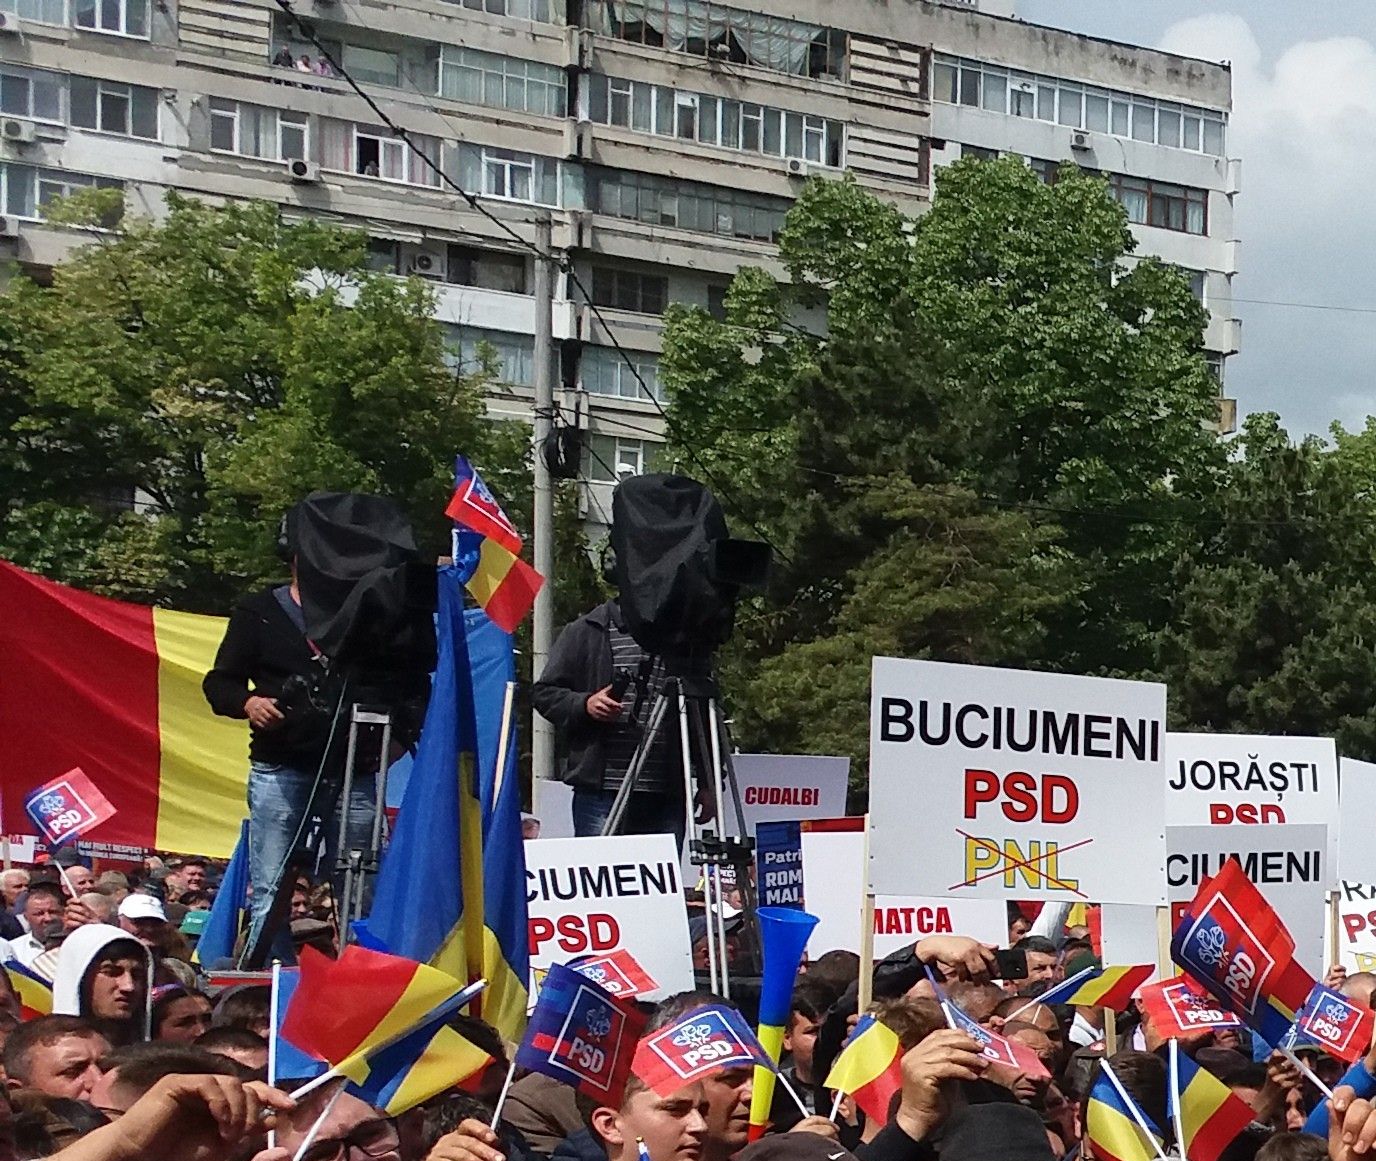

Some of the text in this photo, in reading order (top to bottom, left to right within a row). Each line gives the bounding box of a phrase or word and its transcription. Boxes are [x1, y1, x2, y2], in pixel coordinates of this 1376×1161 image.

[880, 697, 1160, 762] BUCIUMENI
[1168, 753, 1319, 802] JORĂȘTI
[744, 786, 820, 806] CUDALBI
[963, 769, 1080, 825] PSD
[48, 808, 83, 836] PSD
[1209, 803, 1286, 825] PSD
[964, 836, 1080, 893] PNL
[766, 887, 799, 906] MAI
[528, 913, 621, 955] PSD
[1223, 951, 1257, 999] PSD
[1185, 1009, 1225, 1024] PSD
[1313, 1018, 1342, 1042] PSD
[566, 1036, 606, 1074] PSD
[682, 1039, 734, 1067] PSD
